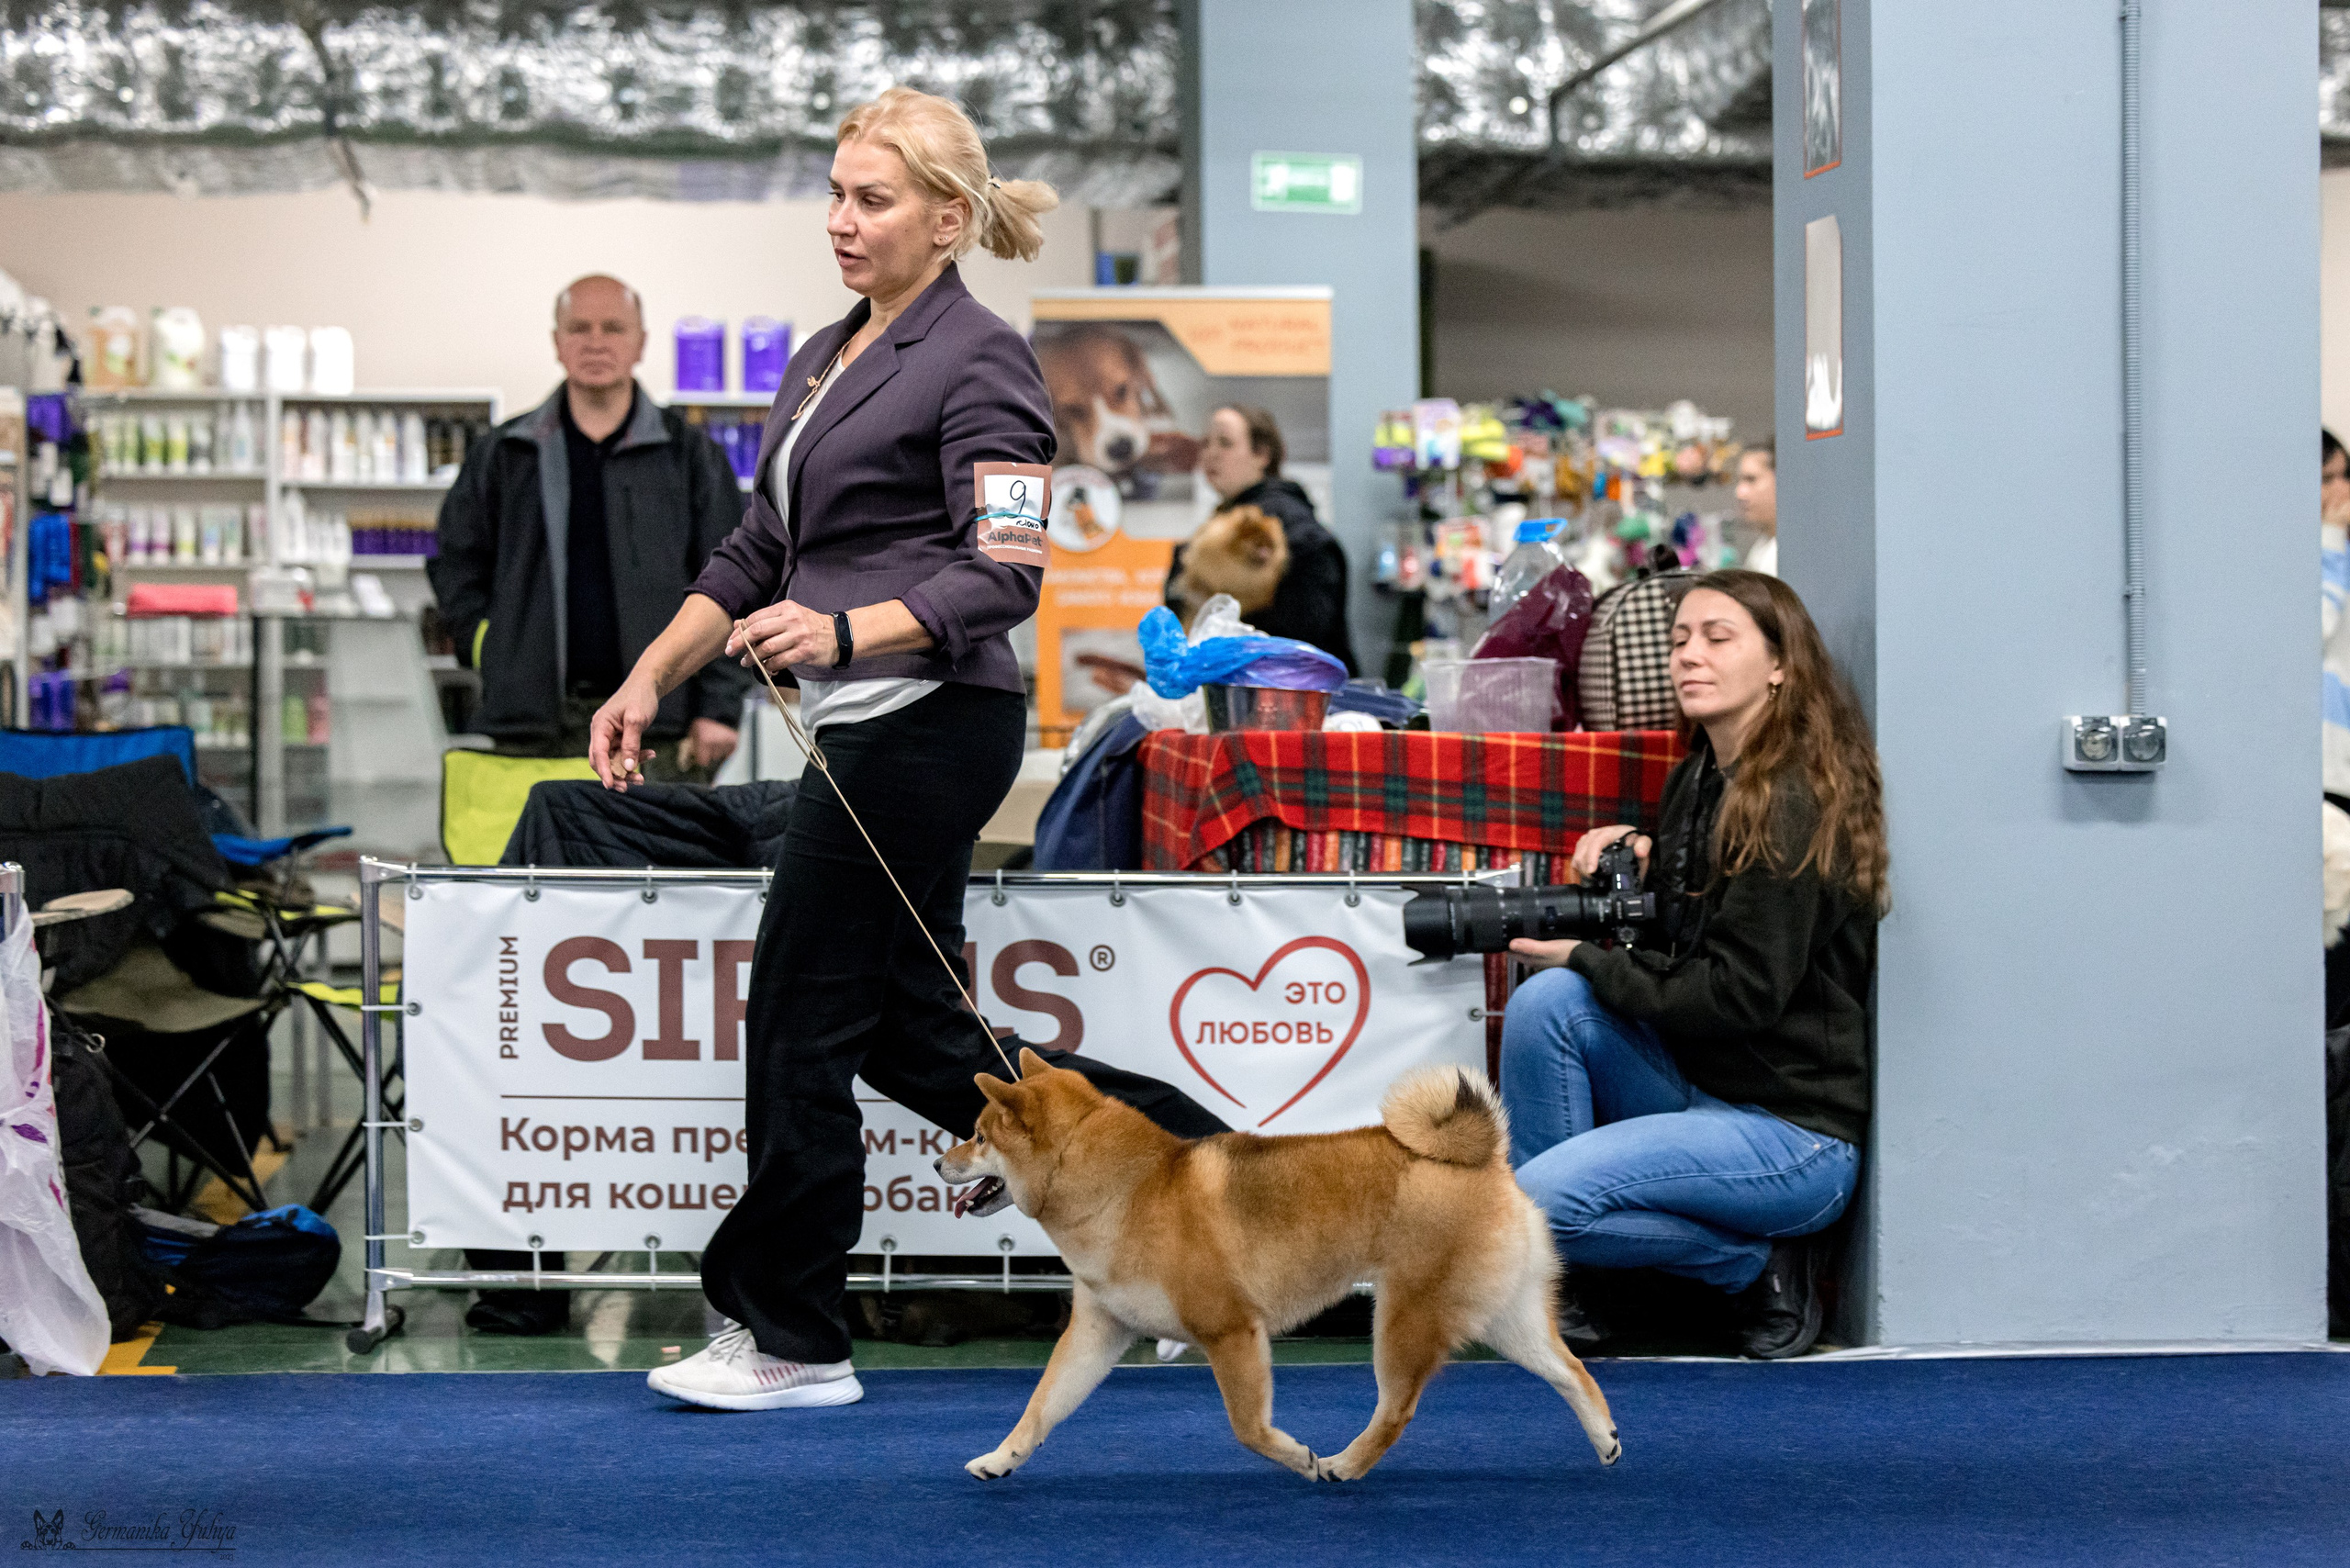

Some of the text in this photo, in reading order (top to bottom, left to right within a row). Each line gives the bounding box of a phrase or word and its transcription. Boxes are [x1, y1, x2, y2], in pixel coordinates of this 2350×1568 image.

[1010, 480, 1026, 514] 9
[988, 532, 1043, 546] AlphaPet
[499, 936, 519, 1059] PREMIUM
[1285, 981, 1346, 1004] ЭТО
[1196, 1021, 1333, 1044] ЛЮБОВЬ
[500, 1117, 655, 1160] Корма
[503, 1175, 970, 1213] для коше обак
